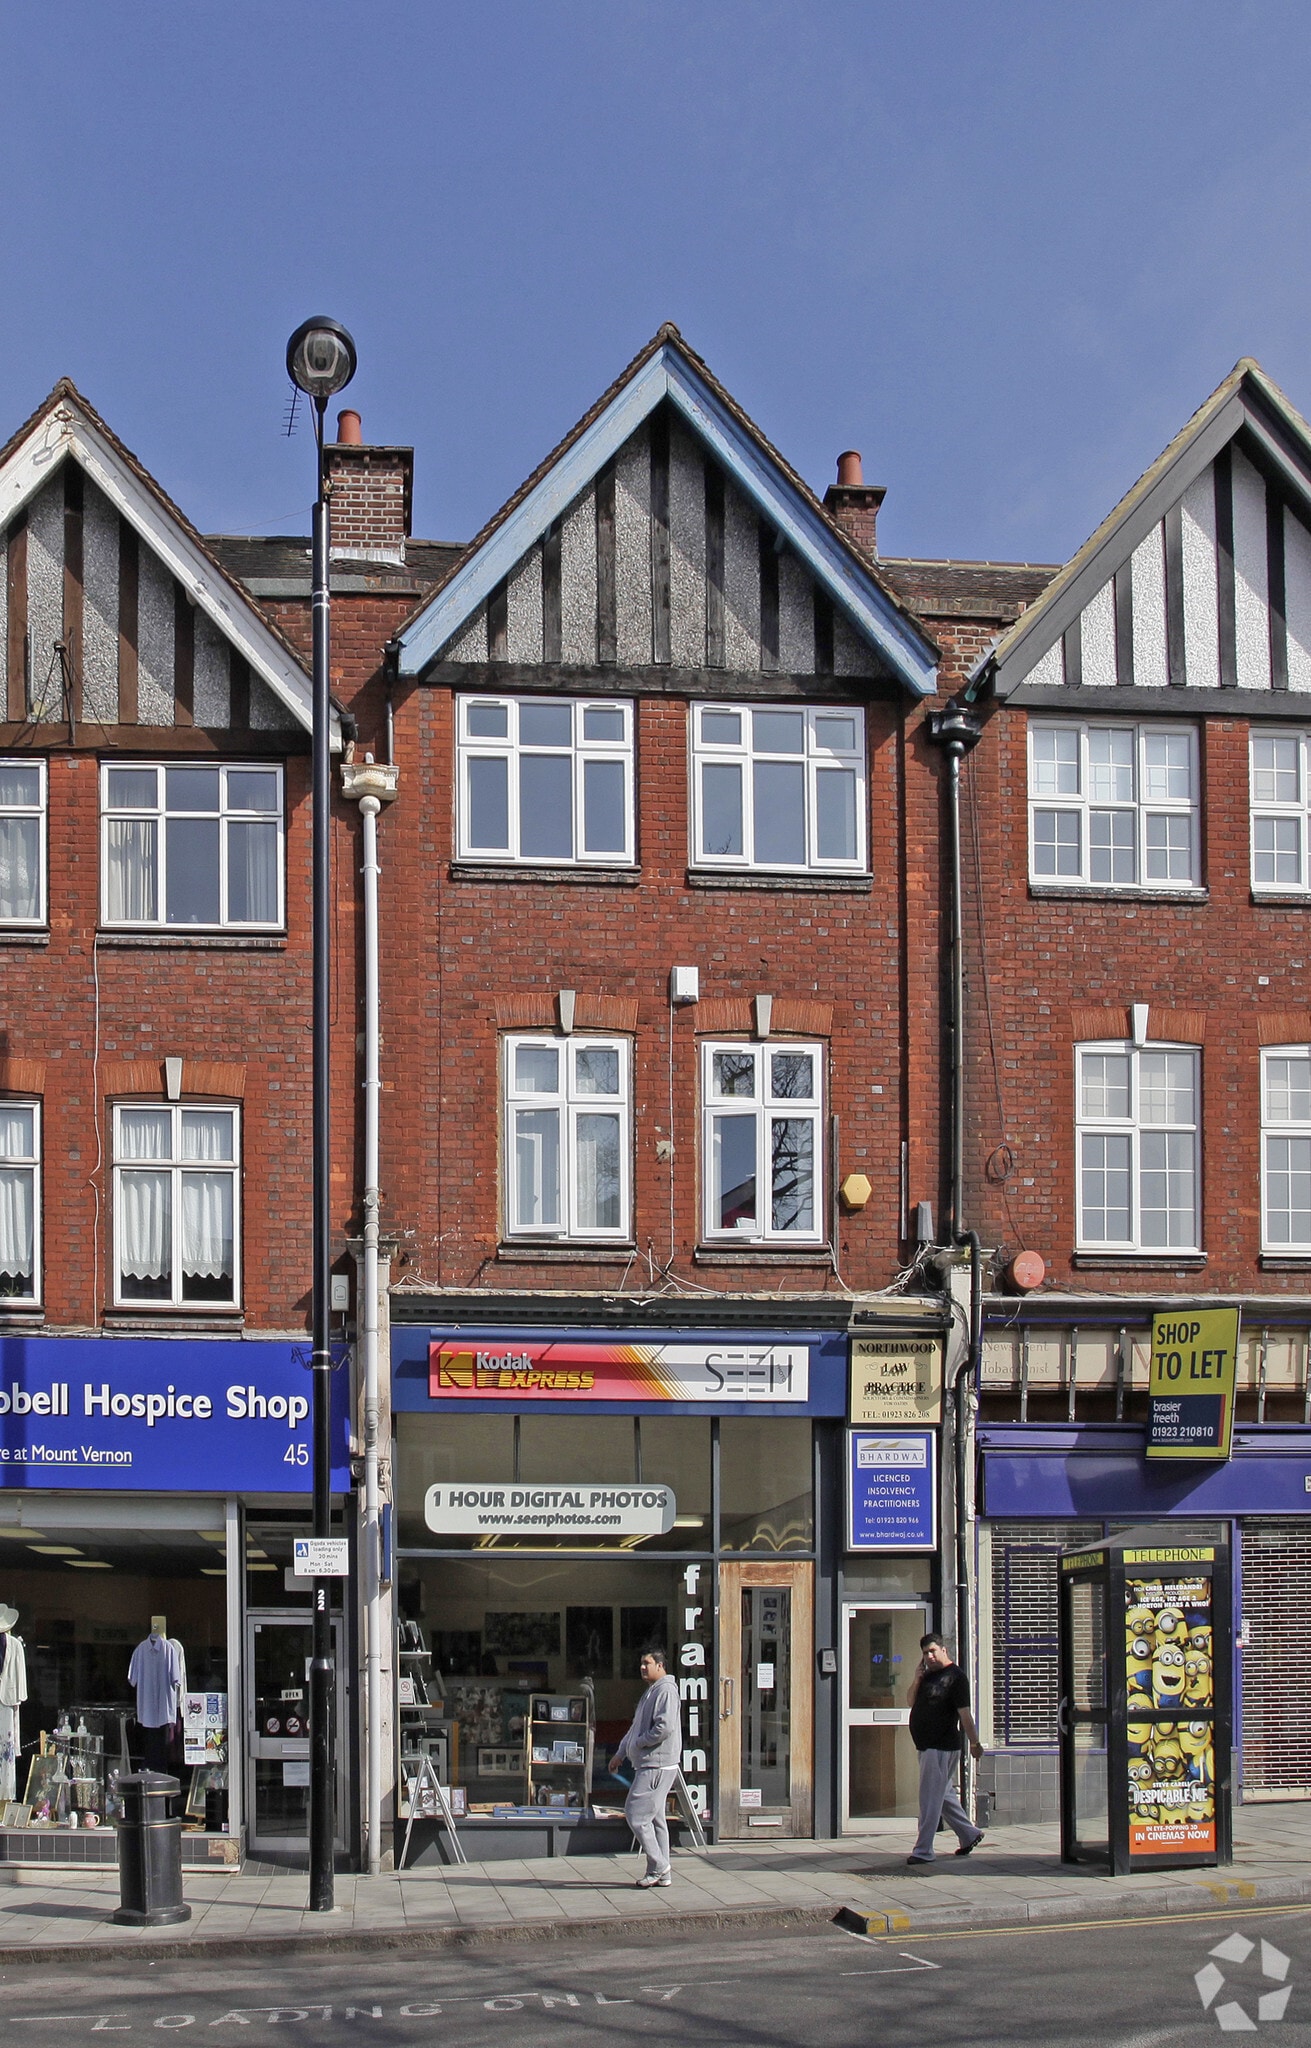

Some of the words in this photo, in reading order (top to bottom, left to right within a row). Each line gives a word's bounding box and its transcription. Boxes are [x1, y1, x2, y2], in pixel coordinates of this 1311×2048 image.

[1157, 1322, 1200, 1345] SHOP
[858, 1343, 936, 1354] NORTHWOOD
[983, 1338, 1049, 1351] Newsaent
[476, 1352, 533, 1370] Kodak
[1155, 1351, 1182, 1380] TO
[1190, 1350, 1227, 1379] LET
[882, 1363, 910, 1374] LAW
[497, 1370, 595, 1389] EXPRESS
[866, 1382, 926, 1393] PRACTICE
[84, 1383, 212, 1426] Hospice
[226, 1385, 309, 1428] Shop
[1153, 1400, 1181, 1412] brasier
[882, 1411, 903, 1419] 01923
[1153, 1413, 1179, 1423] freeth
[1152, 1427, 1178, 1437] 01923
[1180, 1426, 1213, 1437] 210810
[0, 1448, 10, 1460] e
[14, 1447, 28, 1460] at
[31, 1444, 78, 1461] Mount
[81, 1446, 132, 1462] Vernon
[283, 1444, 309, 1465] 45
[860, 1453, 924, 1461] BHARDWAJ
[873, 1474, 911, 1482] LICENCED
[867, 1487, 916, 1495] INSOLVENCY
[433, 1491, 442, 1507] 1
[449, 1491, 505, 1507] HOUR
[510, 1491, 585, 1508] DIGITAL
[590, 1491, 667, 1508] PHOTOS
[863, 1500, 920, 1508] PRACTITIONERS
[478, 1512, 622, 1527] www.seenphotos.com
[1066, 1553, 1099, 1569] TELEPHONE
[1132, 1549, 1206, 1562] TELEPHONE
[679, 1564, 708, 1815] framing
[1134, 1789, 1191, 1804] DESPICABLE
[1192, 1788, 1208, 1802] ME
[1135, 1832, 1145, 1840] IN
[1148, 1831, 1185, 1840] CINEMAS
[1187, 1831, 1209, 1839] NOW
[90, 2003, 442, 2031] LOADING
[483, 1987, 682, 2011] ONLY
